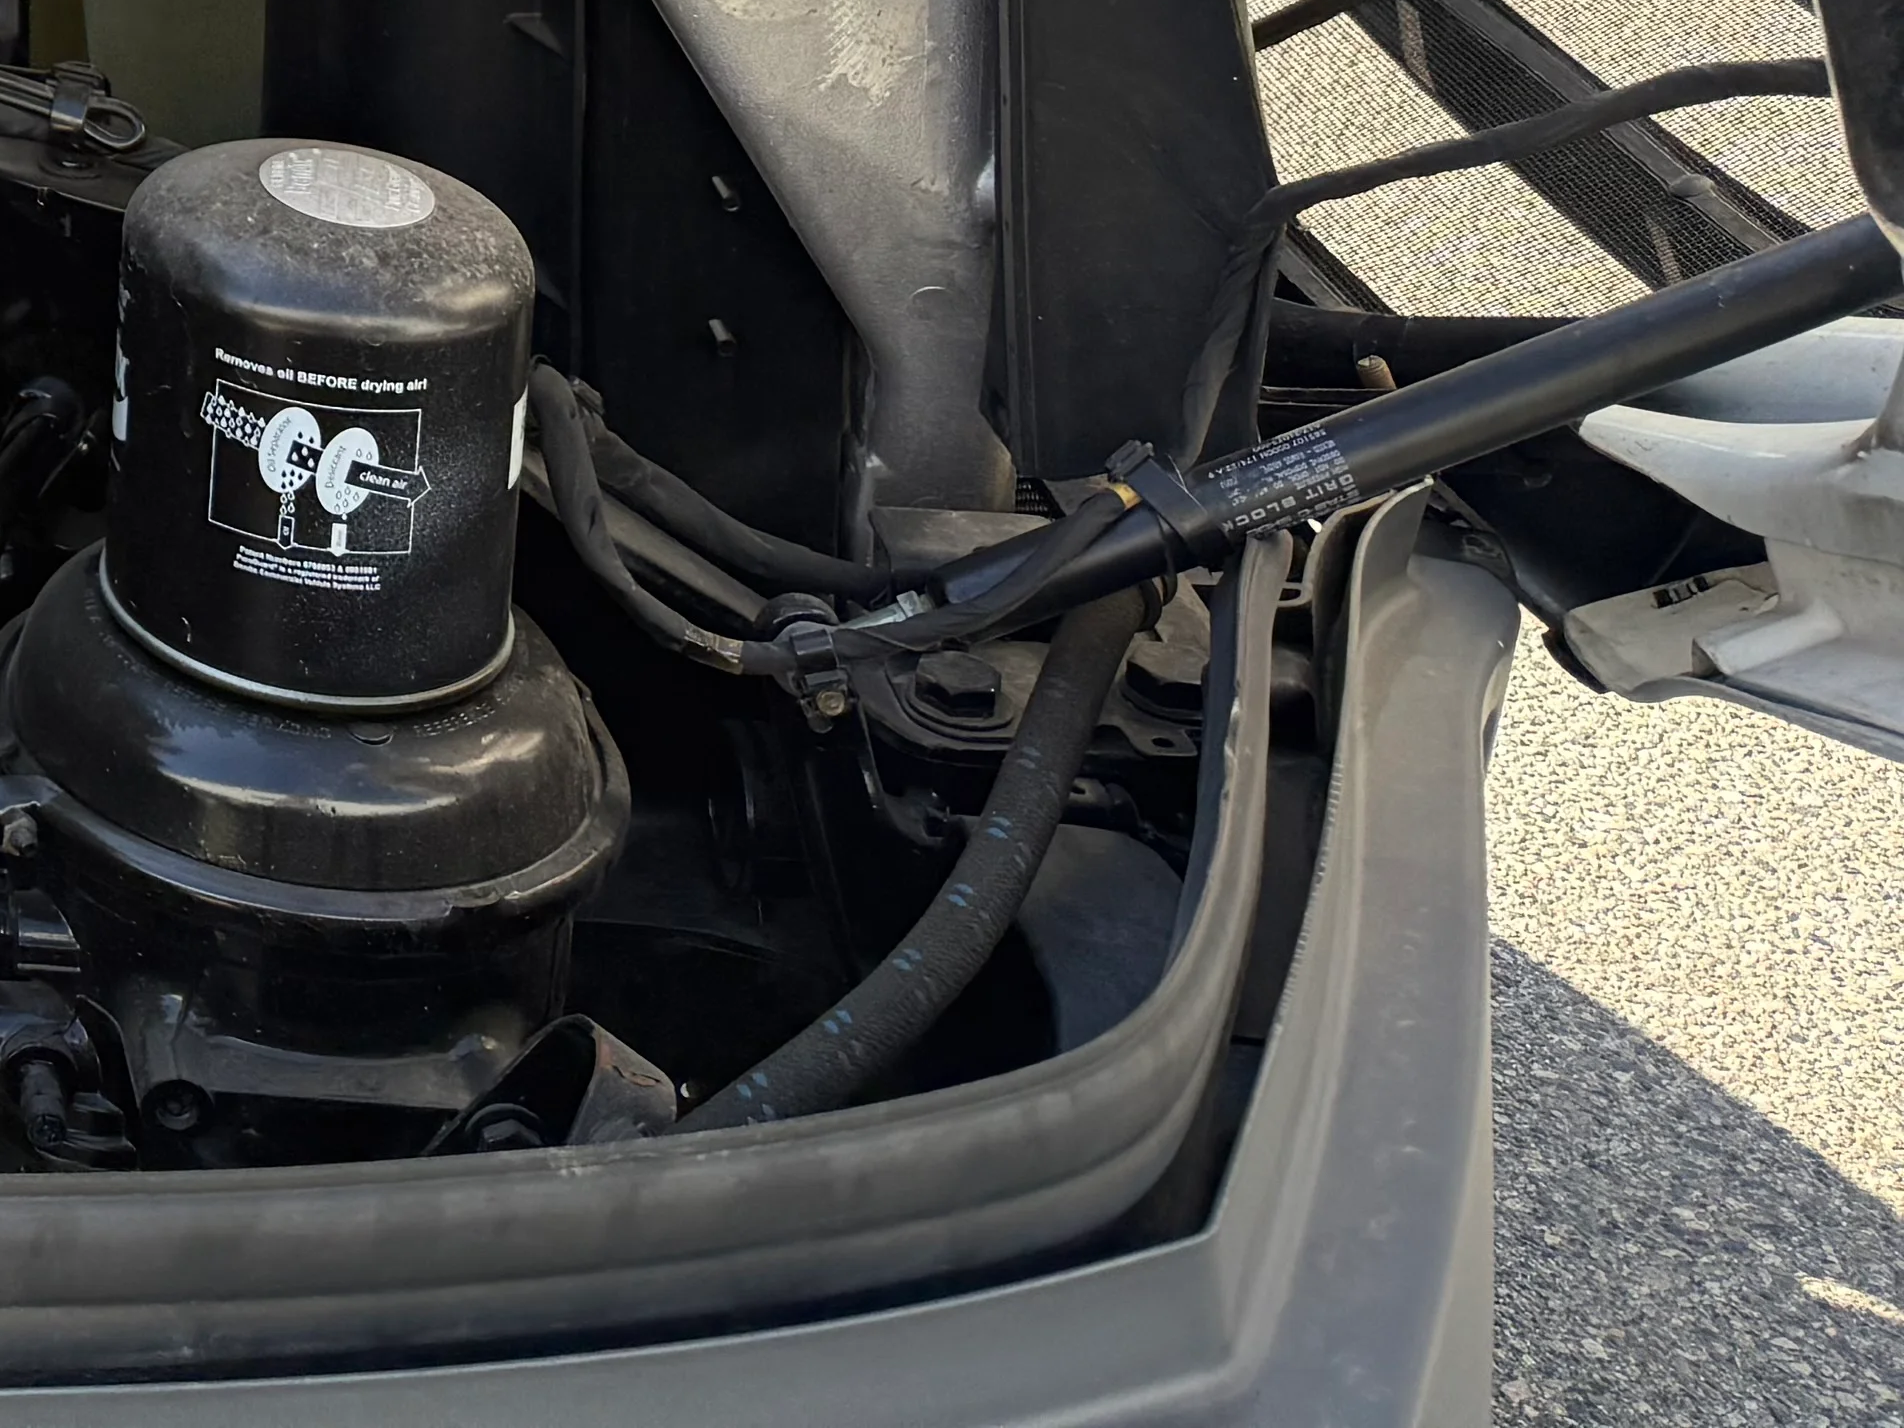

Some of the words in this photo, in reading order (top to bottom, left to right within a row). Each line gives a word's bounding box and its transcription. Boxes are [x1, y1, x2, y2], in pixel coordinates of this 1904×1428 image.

[215, 347, 274, 377] Removes
[276, 368, 294, 381] oil
[297, 371, 358, 390] BEFORE
[360, 379, 404, 394] drying
[359, 471, 392, 487] clean
[392, 479, 408, 491] air
